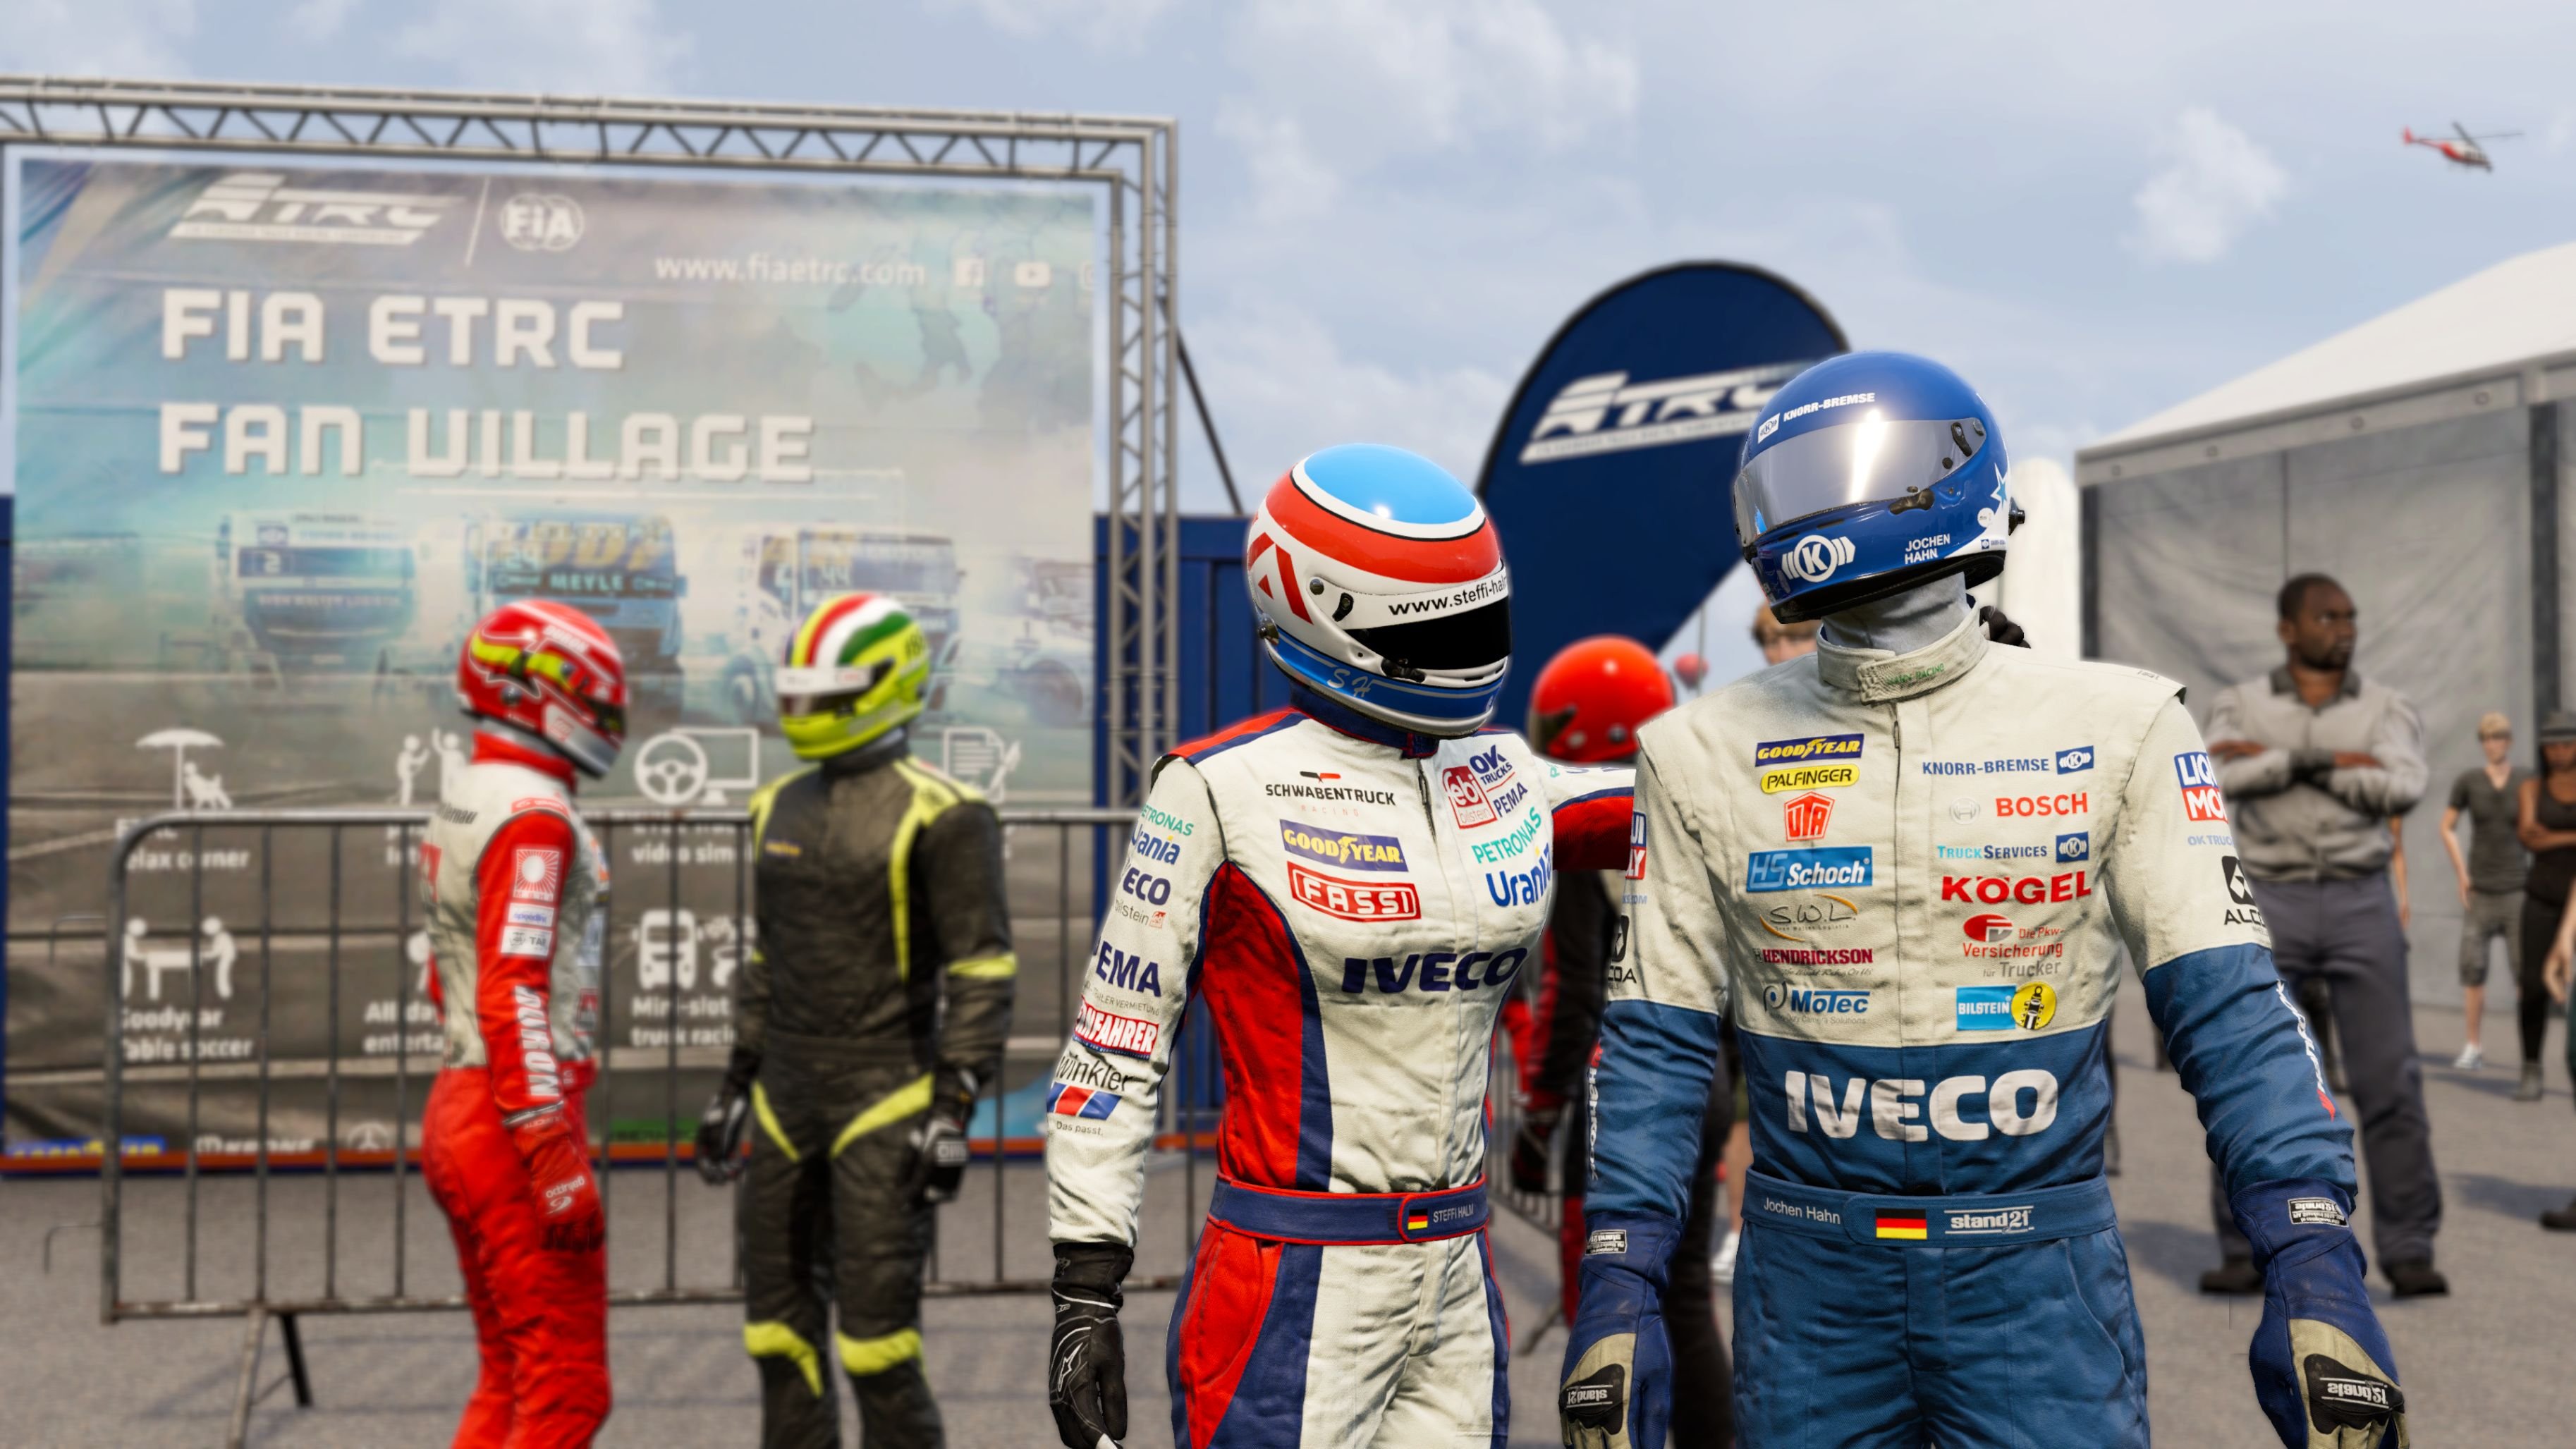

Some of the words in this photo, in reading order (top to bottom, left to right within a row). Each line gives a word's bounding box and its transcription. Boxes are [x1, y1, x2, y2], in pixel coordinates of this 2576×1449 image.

[506, 200, 573, 240] FIA
[656, 252, 925, 286] www.fiaetrc.com
[162, 288, 324, 362] FIA
[369, 295, 623, 369] ETRC
[1783, 392, 1876, 422] KNORR-BREMSE
[159, 402, 363, 477] FAN
[407, 408, 813, 484] VILLAGE
[1905, 534, 1951, 553] JOCHEN
[1905, 549, 1939, 564] HAHN
[1470, 745, 1506, 774] OK
[1757, 738, 1861, 759] GOODYEAR
[1481, 762, 1513, 785] TRUCKS
[1767, 769, 1852, 789] PALFINGER
[1922, 758, 2050, 776] KNORR-BREMSE
[1265, 784, 1396, 806] SCHWABENTRUCK
[1444, 769, 1481, 807] febi
[1493, 782, 1528, 818] PEMA
[1300, 804, 1360, 817] RACING
[1460, 807, 1490, 824] bilstein
[1996, 792, 2089, 817] BOSCH
[1283, 829, 1404, 864] GOODYEAR
[1471, 807, 1542, 864] PETRONAS
[2187, 836, 2206, 846] OK
[2207, 835, 2234, 846] TRUC
[127, 847, 172, 871] elax
[178, 850, 250, 869] crner
[1750, 852, 1788, 888] HS
[1787, 861, 1866, 887] Schoch
[1123, 867, 1171, 905] ECO
[1303, 877, 1410, 914] FASSI
[1941, 869, 2092, 905] KÖGEL
[2019, 928, 2036, 939] Die
[1762, 948, 1874, 965] HENDRICKSON
[1962, 942, 2063, 958] Versicherung
[1095, 941, 1161, 998] EMA
[1341, 948, 1528, 994] IVECO
[2000, 961, 2061, 978] Trucker
[123, 1005, 224, 1032] oodyar
[1958, 1001, 2010, 1015] BILSTEIN
[1785, 1069, 2058, 1142] IVECO
[1056, 1120, 1073, 1132] Das
[1433, 1207, 1457, 1223] STEFFI
[1458, 1203, 1475, 1218] HALM
[1764, 1197, 1804, 1218] Jochen
[1807, 1204, 1841, 1225] Hahn
[1951, 1210, 2032, 1234] stand21
[1567, 1388, 1608, 1406] stand21
